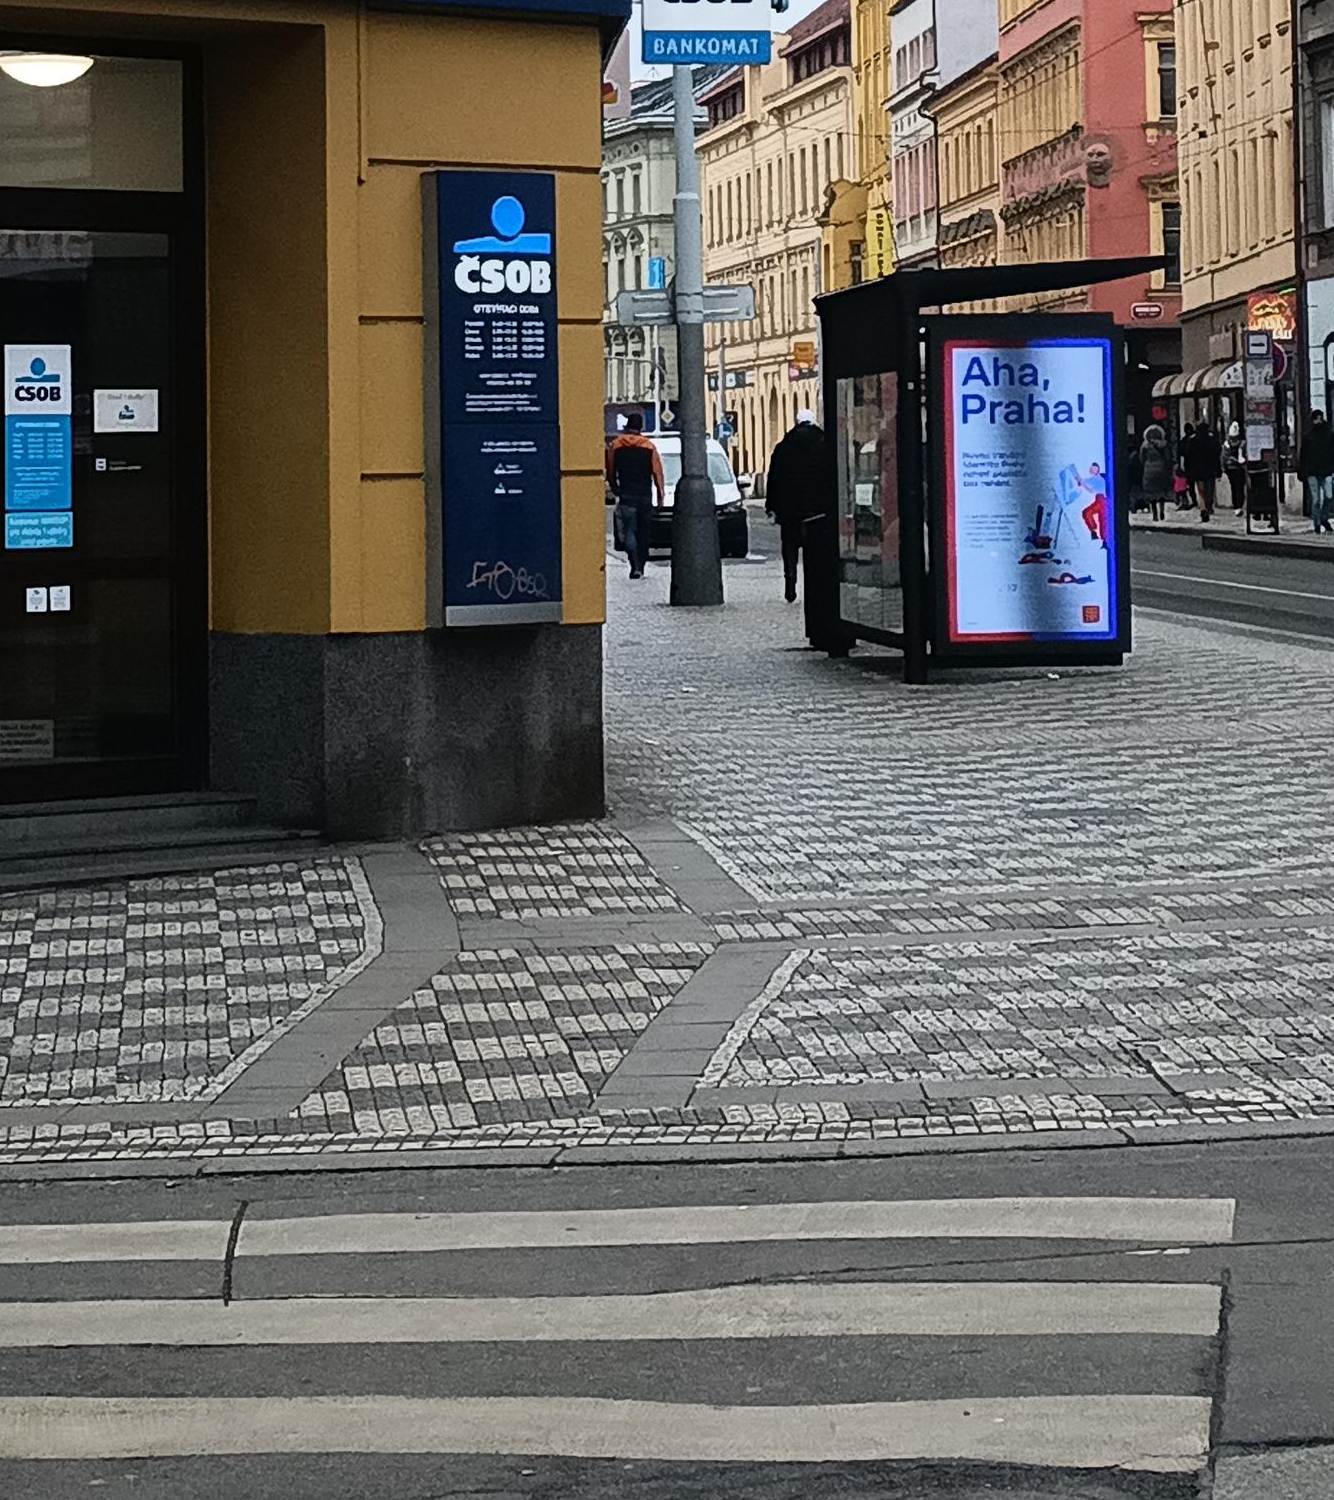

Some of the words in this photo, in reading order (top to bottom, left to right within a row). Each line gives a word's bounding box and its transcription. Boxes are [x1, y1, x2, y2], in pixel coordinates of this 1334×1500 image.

[653, 38, 759, 55] BANKOMAT
[454, 255, 551, 293] ČSOB
[962, 356, 1049, 391] Aha,
[15, 384, 61, 401] ČSOB
[962, 393, 1085, 424] Praha!
